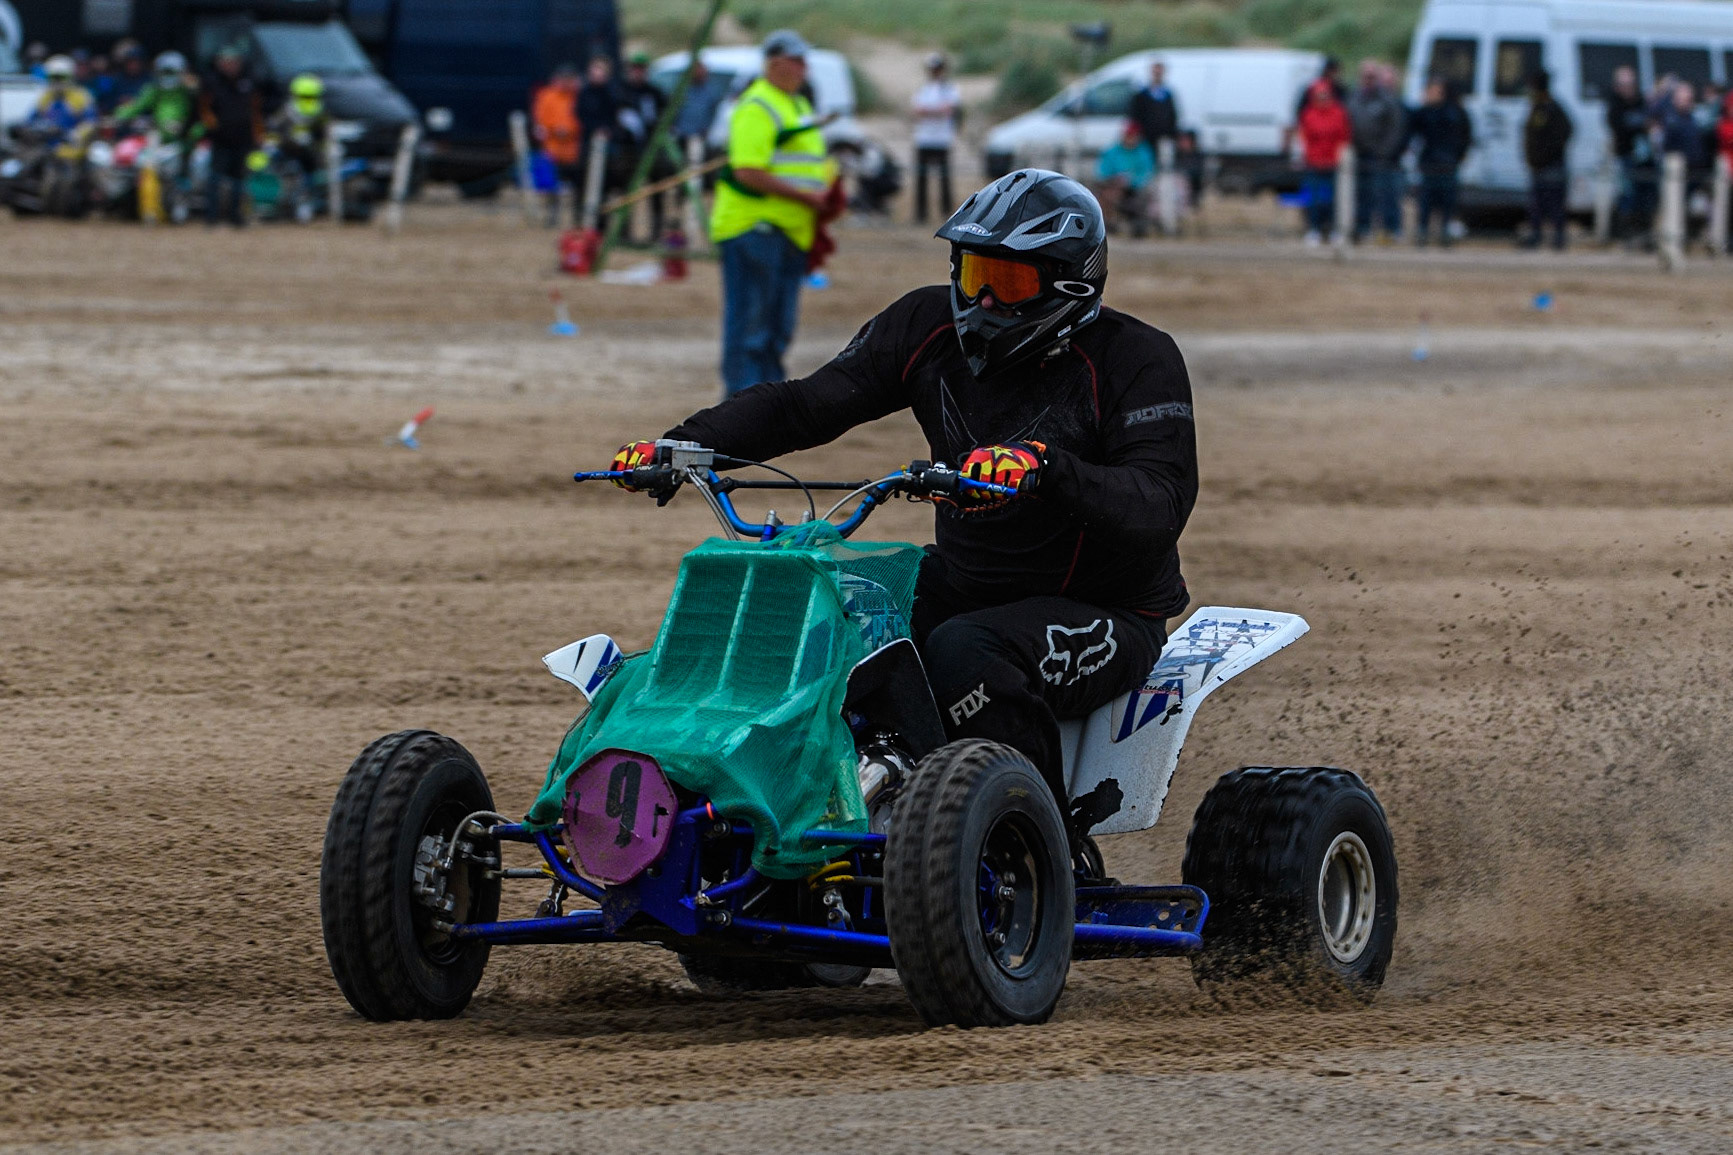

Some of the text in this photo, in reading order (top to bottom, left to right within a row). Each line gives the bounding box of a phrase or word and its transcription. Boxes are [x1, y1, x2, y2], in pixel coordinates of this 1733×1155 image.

[931, 467, 953, 475] ASV
[986, 484, 1008, 493] ASV
[948, 683, 992, 726] FOX
[605, 760, 642, 848] 9
